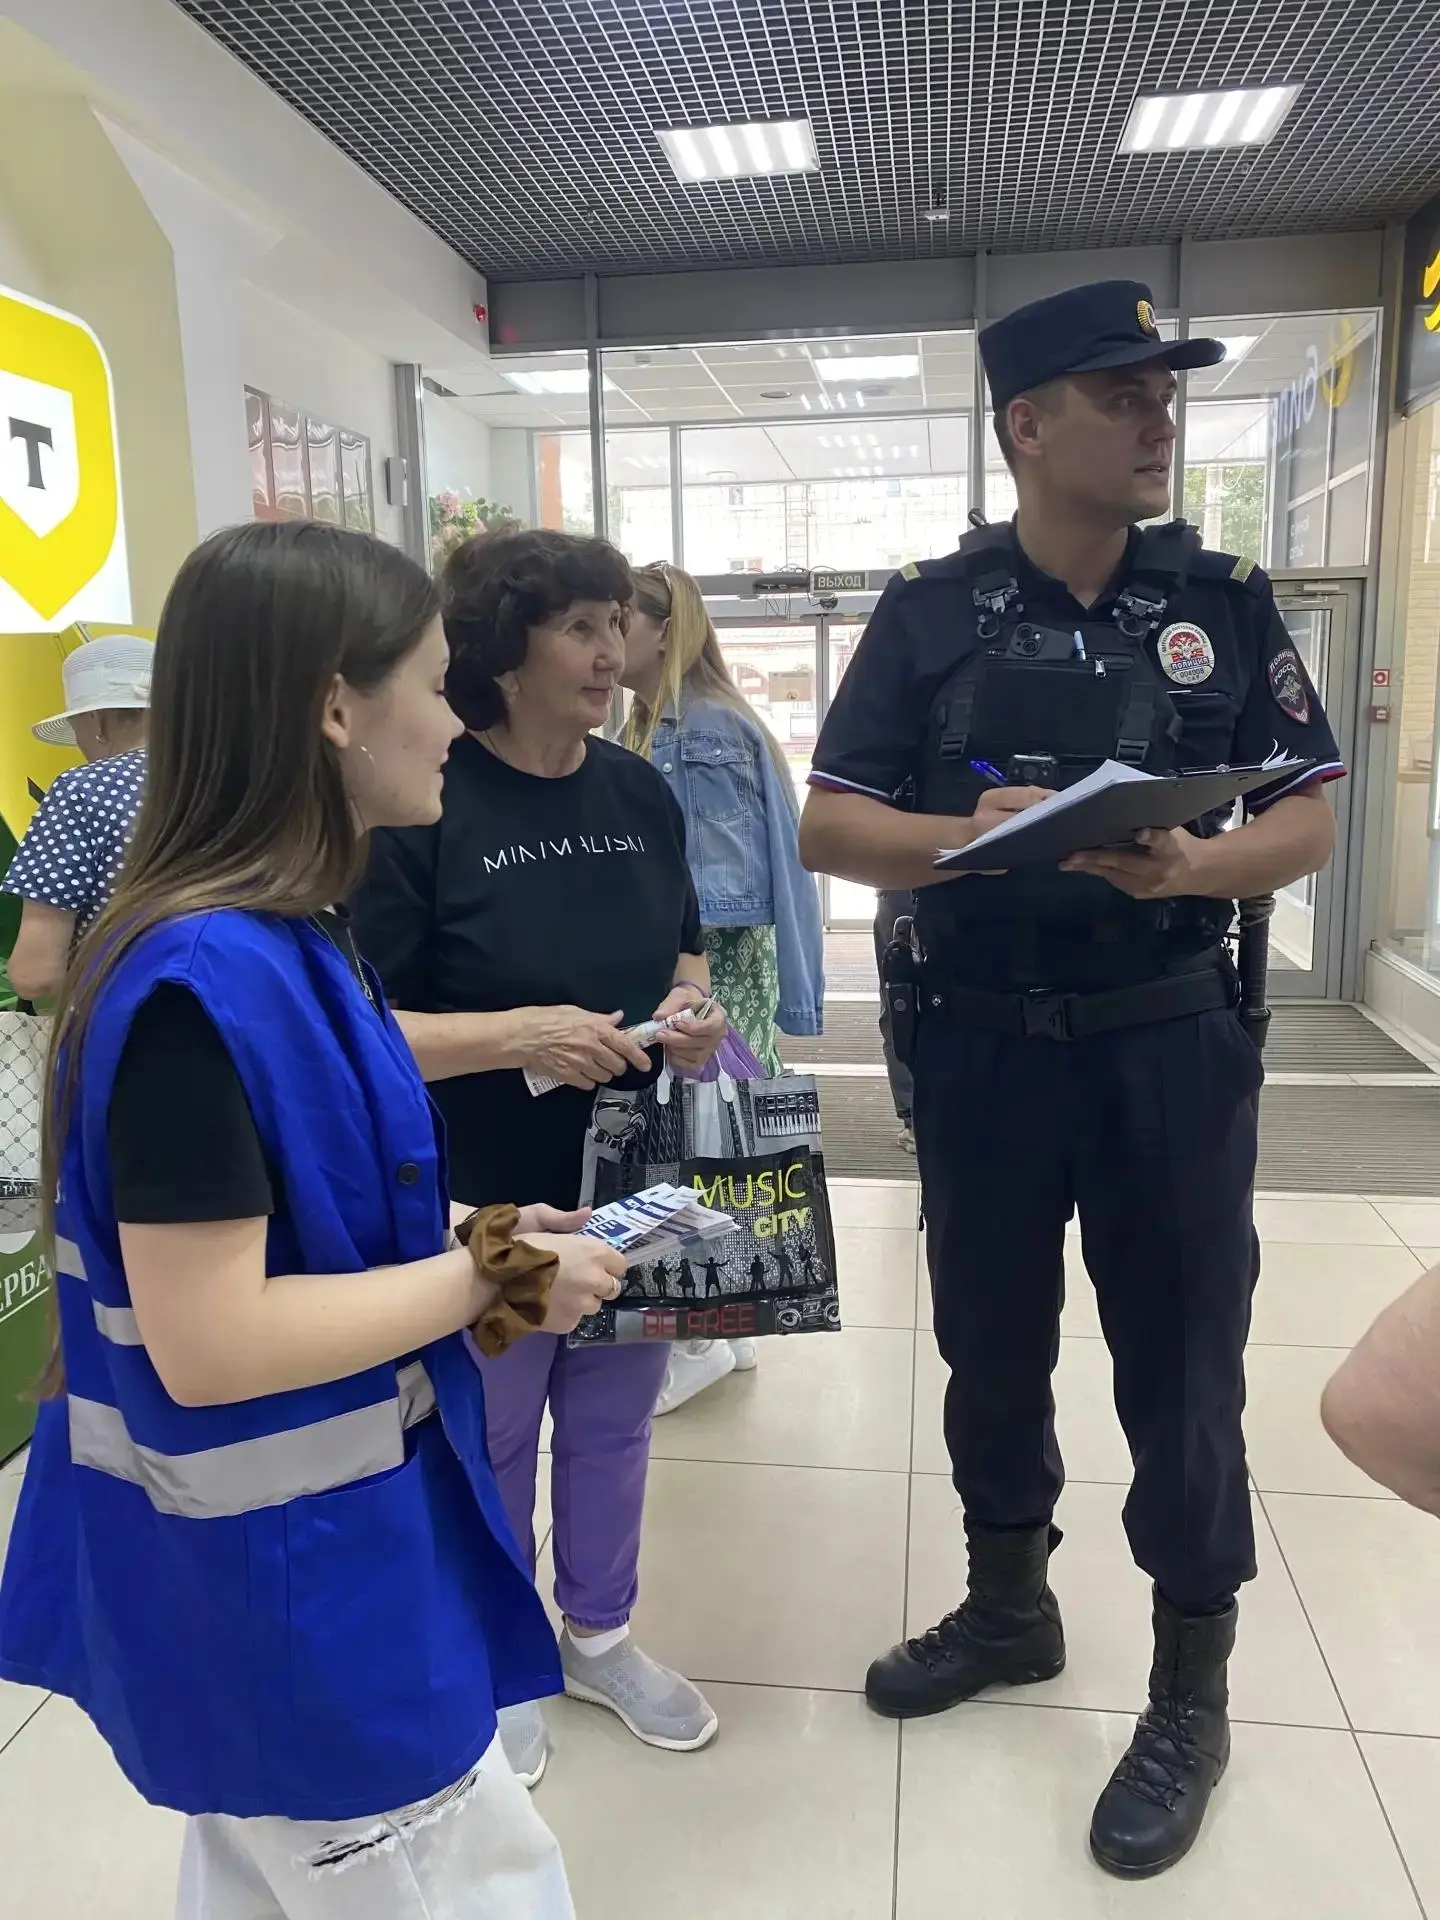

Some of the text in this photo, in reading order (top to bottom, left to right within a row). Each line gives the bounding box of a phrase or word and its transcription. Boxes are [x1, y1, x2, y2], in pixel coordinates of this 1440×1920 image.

[817, 575, 862, 588] ВЫХОД
[1172, 657, 1209, 670] ПОЛИЦИЯ
[482, 834, 645, 874] MINIMALISM
[692, 1163, 808, 1211] MUSIC
[753, 1206, 810, 1239] CITY
[641, 1302, 757, 1337] BE FREE
